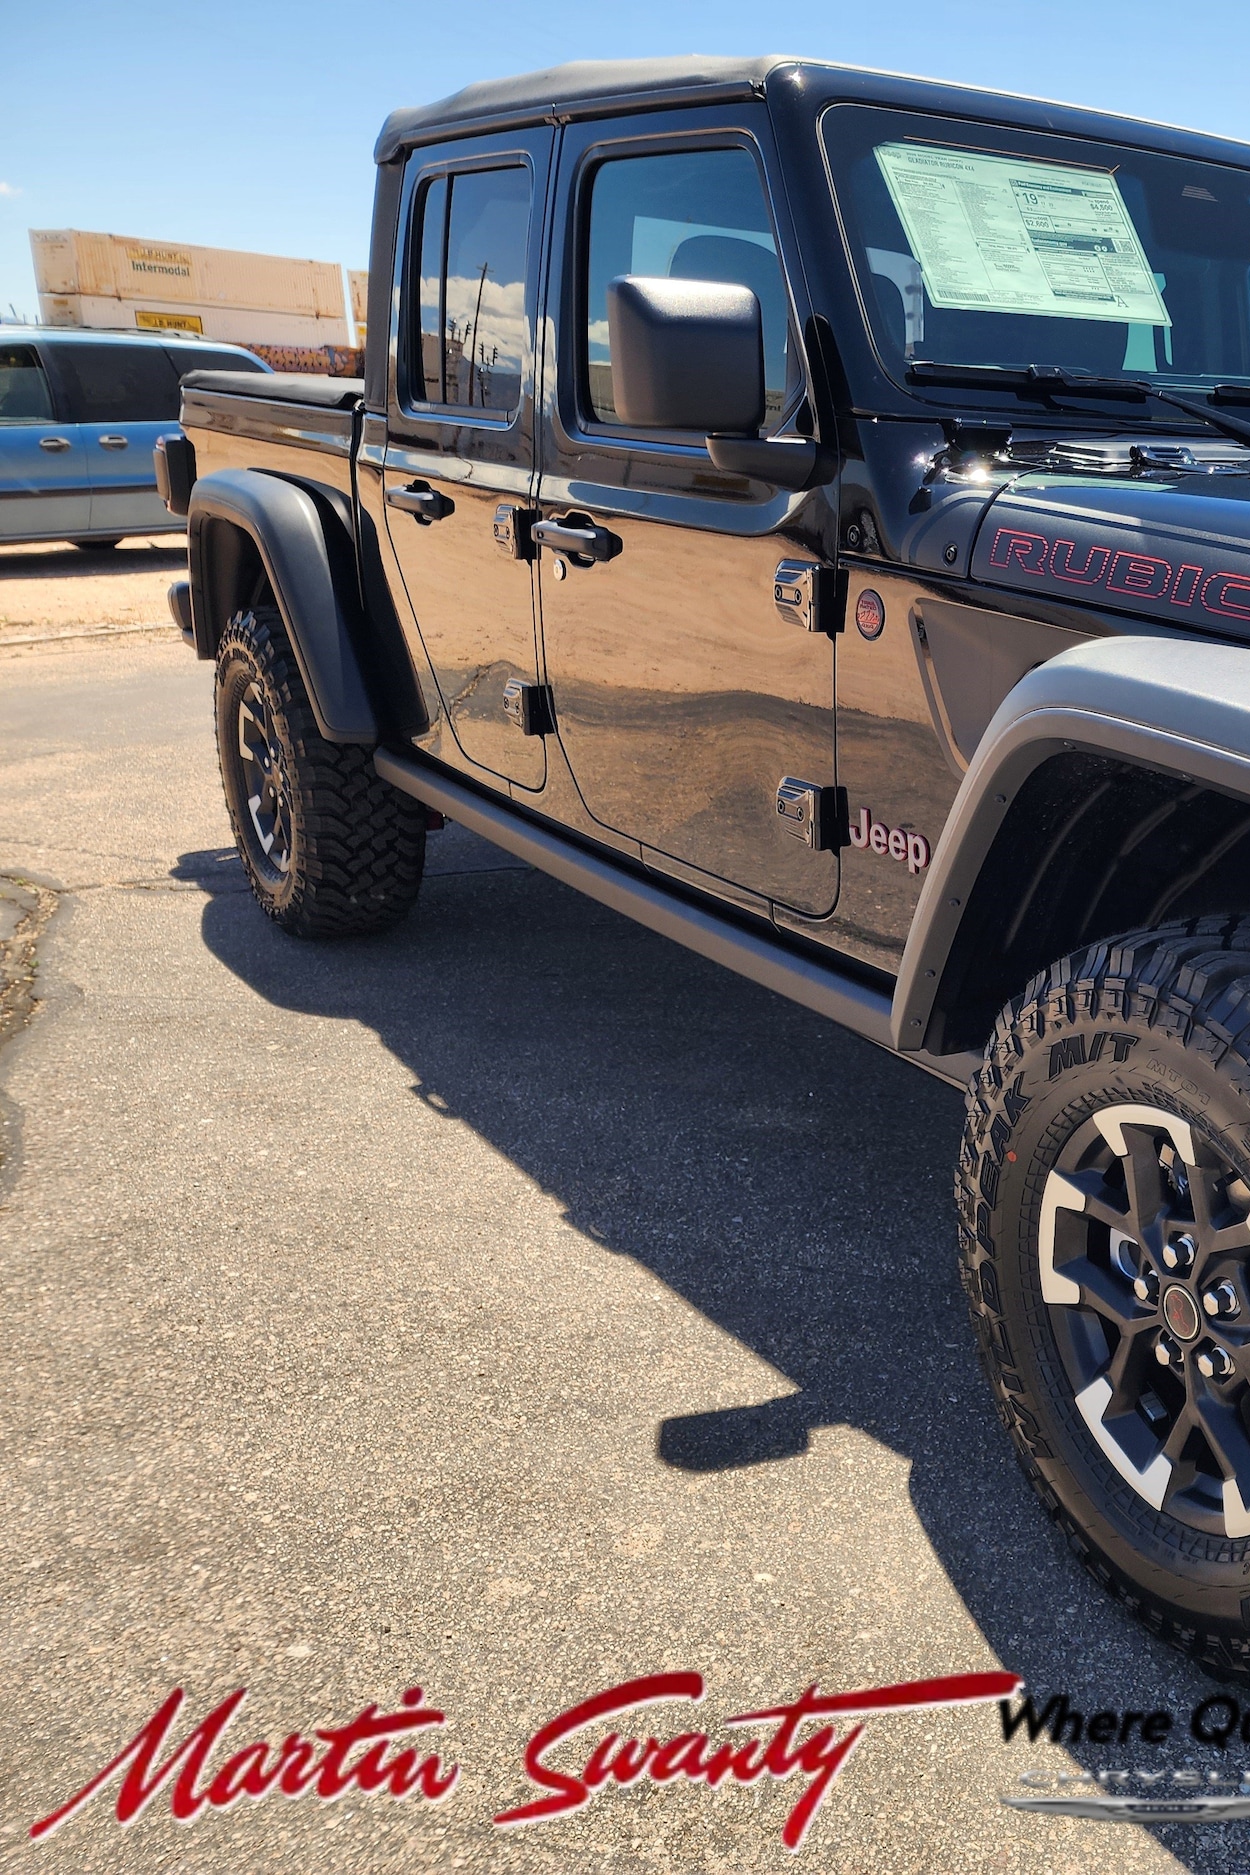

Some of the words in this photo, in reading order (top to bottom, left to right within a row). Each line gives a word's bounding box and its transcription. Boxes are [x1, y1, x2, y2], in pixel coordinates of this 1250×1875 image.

[908, 157, 939, 167] GLADIATOR
[940, 161, 964, 170] RUBICON
[1023, 192, 1038, 205] 19
[132, 261, 190, 277] Intermodal
[848, 806, 931, 874] Jeep
[1048, 1030, 1141, 1081] M/T
[1146, 1057, 1211, 1106] MT01
